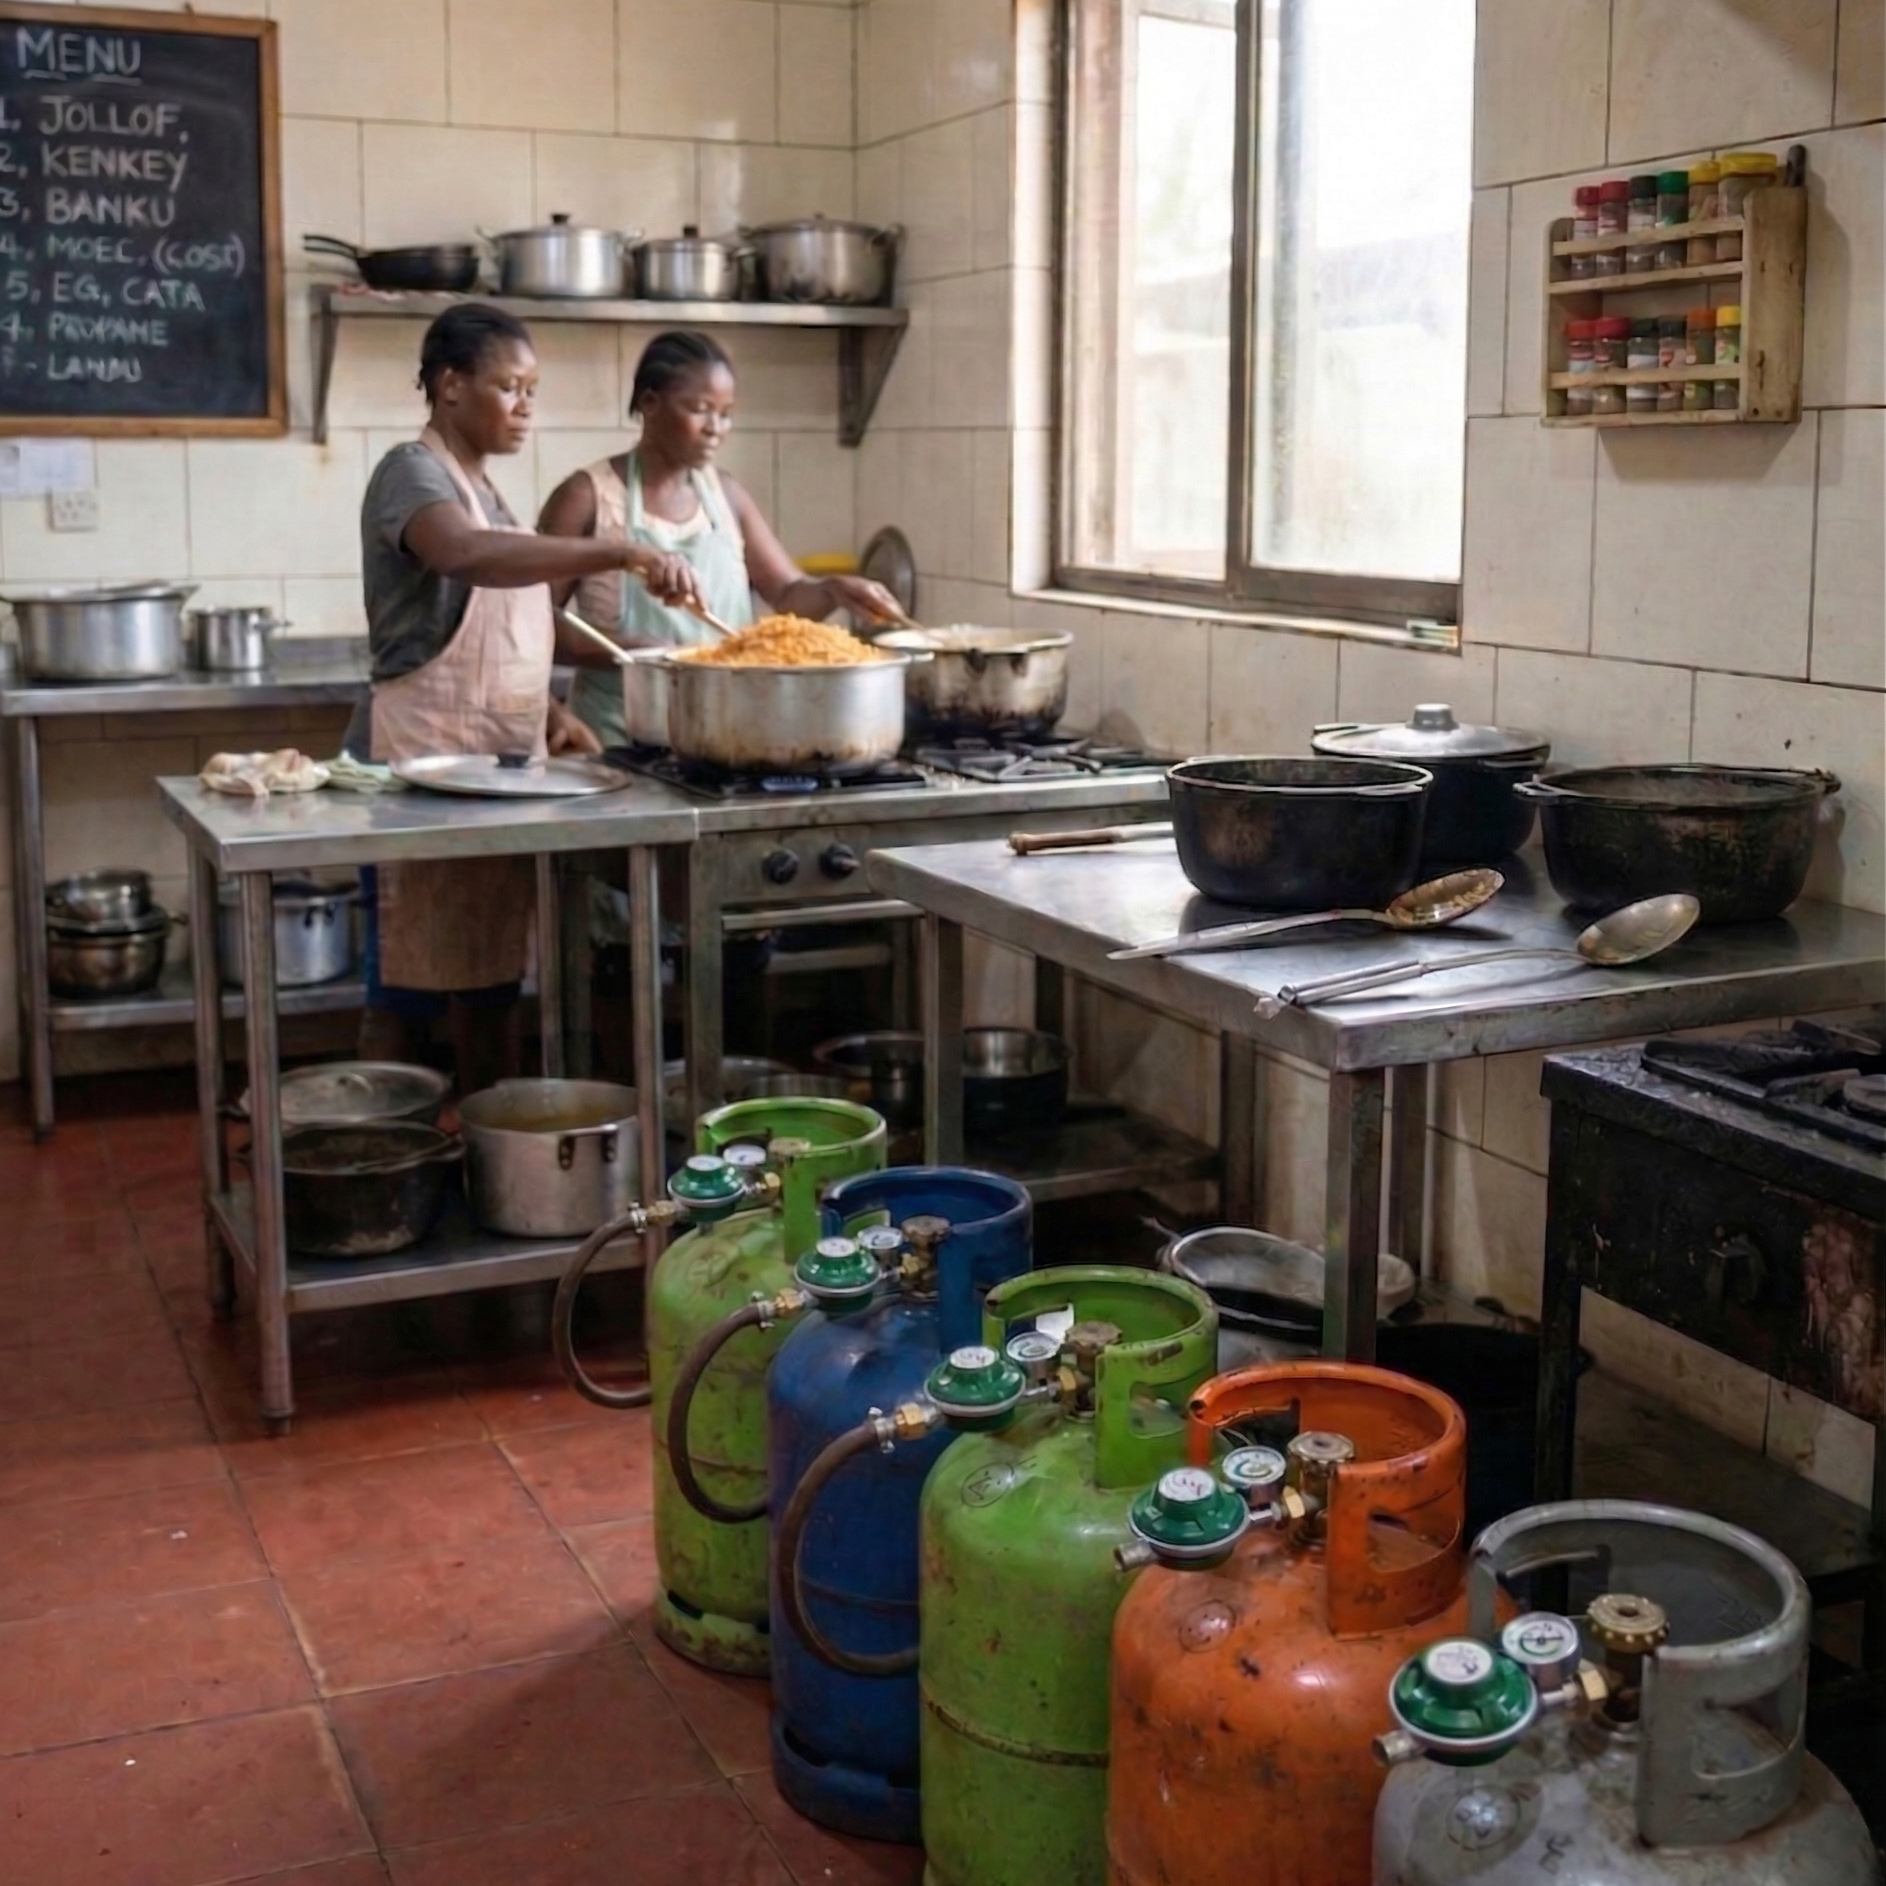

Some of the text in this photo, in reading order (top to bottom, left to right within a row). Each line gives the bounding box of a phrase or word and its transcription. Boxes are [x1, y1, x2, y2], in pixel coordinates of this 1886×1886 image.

[16, 27, 142, 74] MENU
[41, 141, 189, 192] KENKEY
[46, 186, 175, 228] BANKU
[122, 276, 206, 312] CATA
